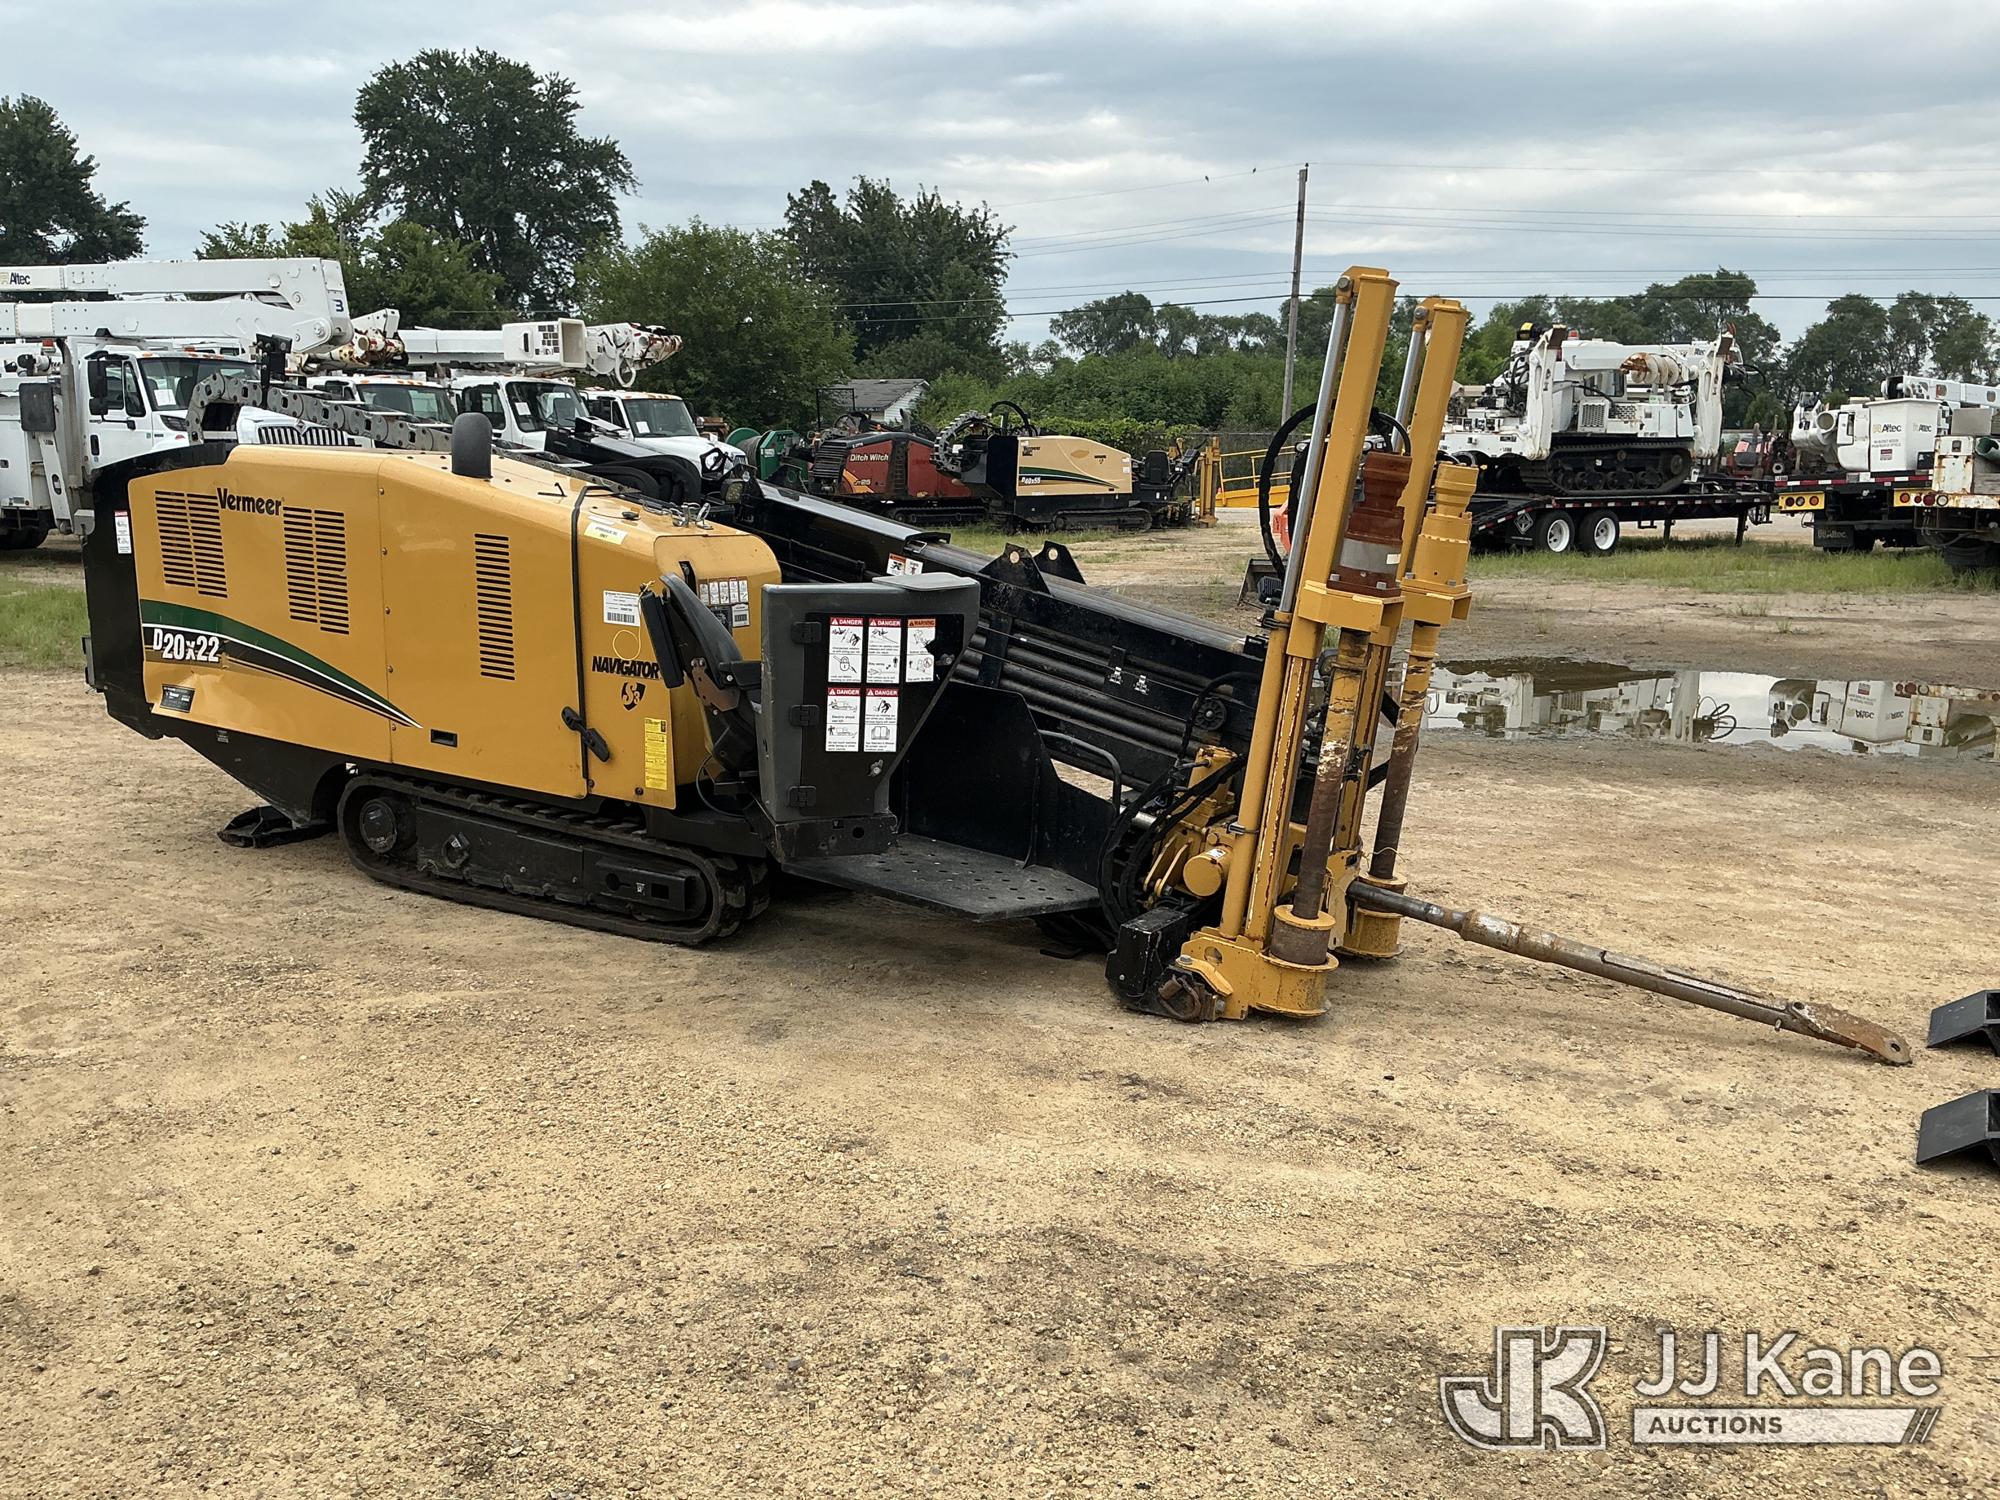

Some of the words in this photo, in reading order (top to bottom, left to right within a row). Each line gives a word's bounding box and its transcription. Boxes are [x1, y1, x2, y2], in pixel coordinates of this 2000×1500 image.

[10, 272, 31, 285] Altec
[1881, 423, 1902, 433] Altec
[850, 453, 868, 462] Ditch
[870, 453, 889, 462] Witch
[216, 487, 282, 516] Vermeer
[152, 628, 220, 662] D20x22
[592, 655, 661, 679] NAVIGATOR
[836, 688, 860, 696] DANGER
